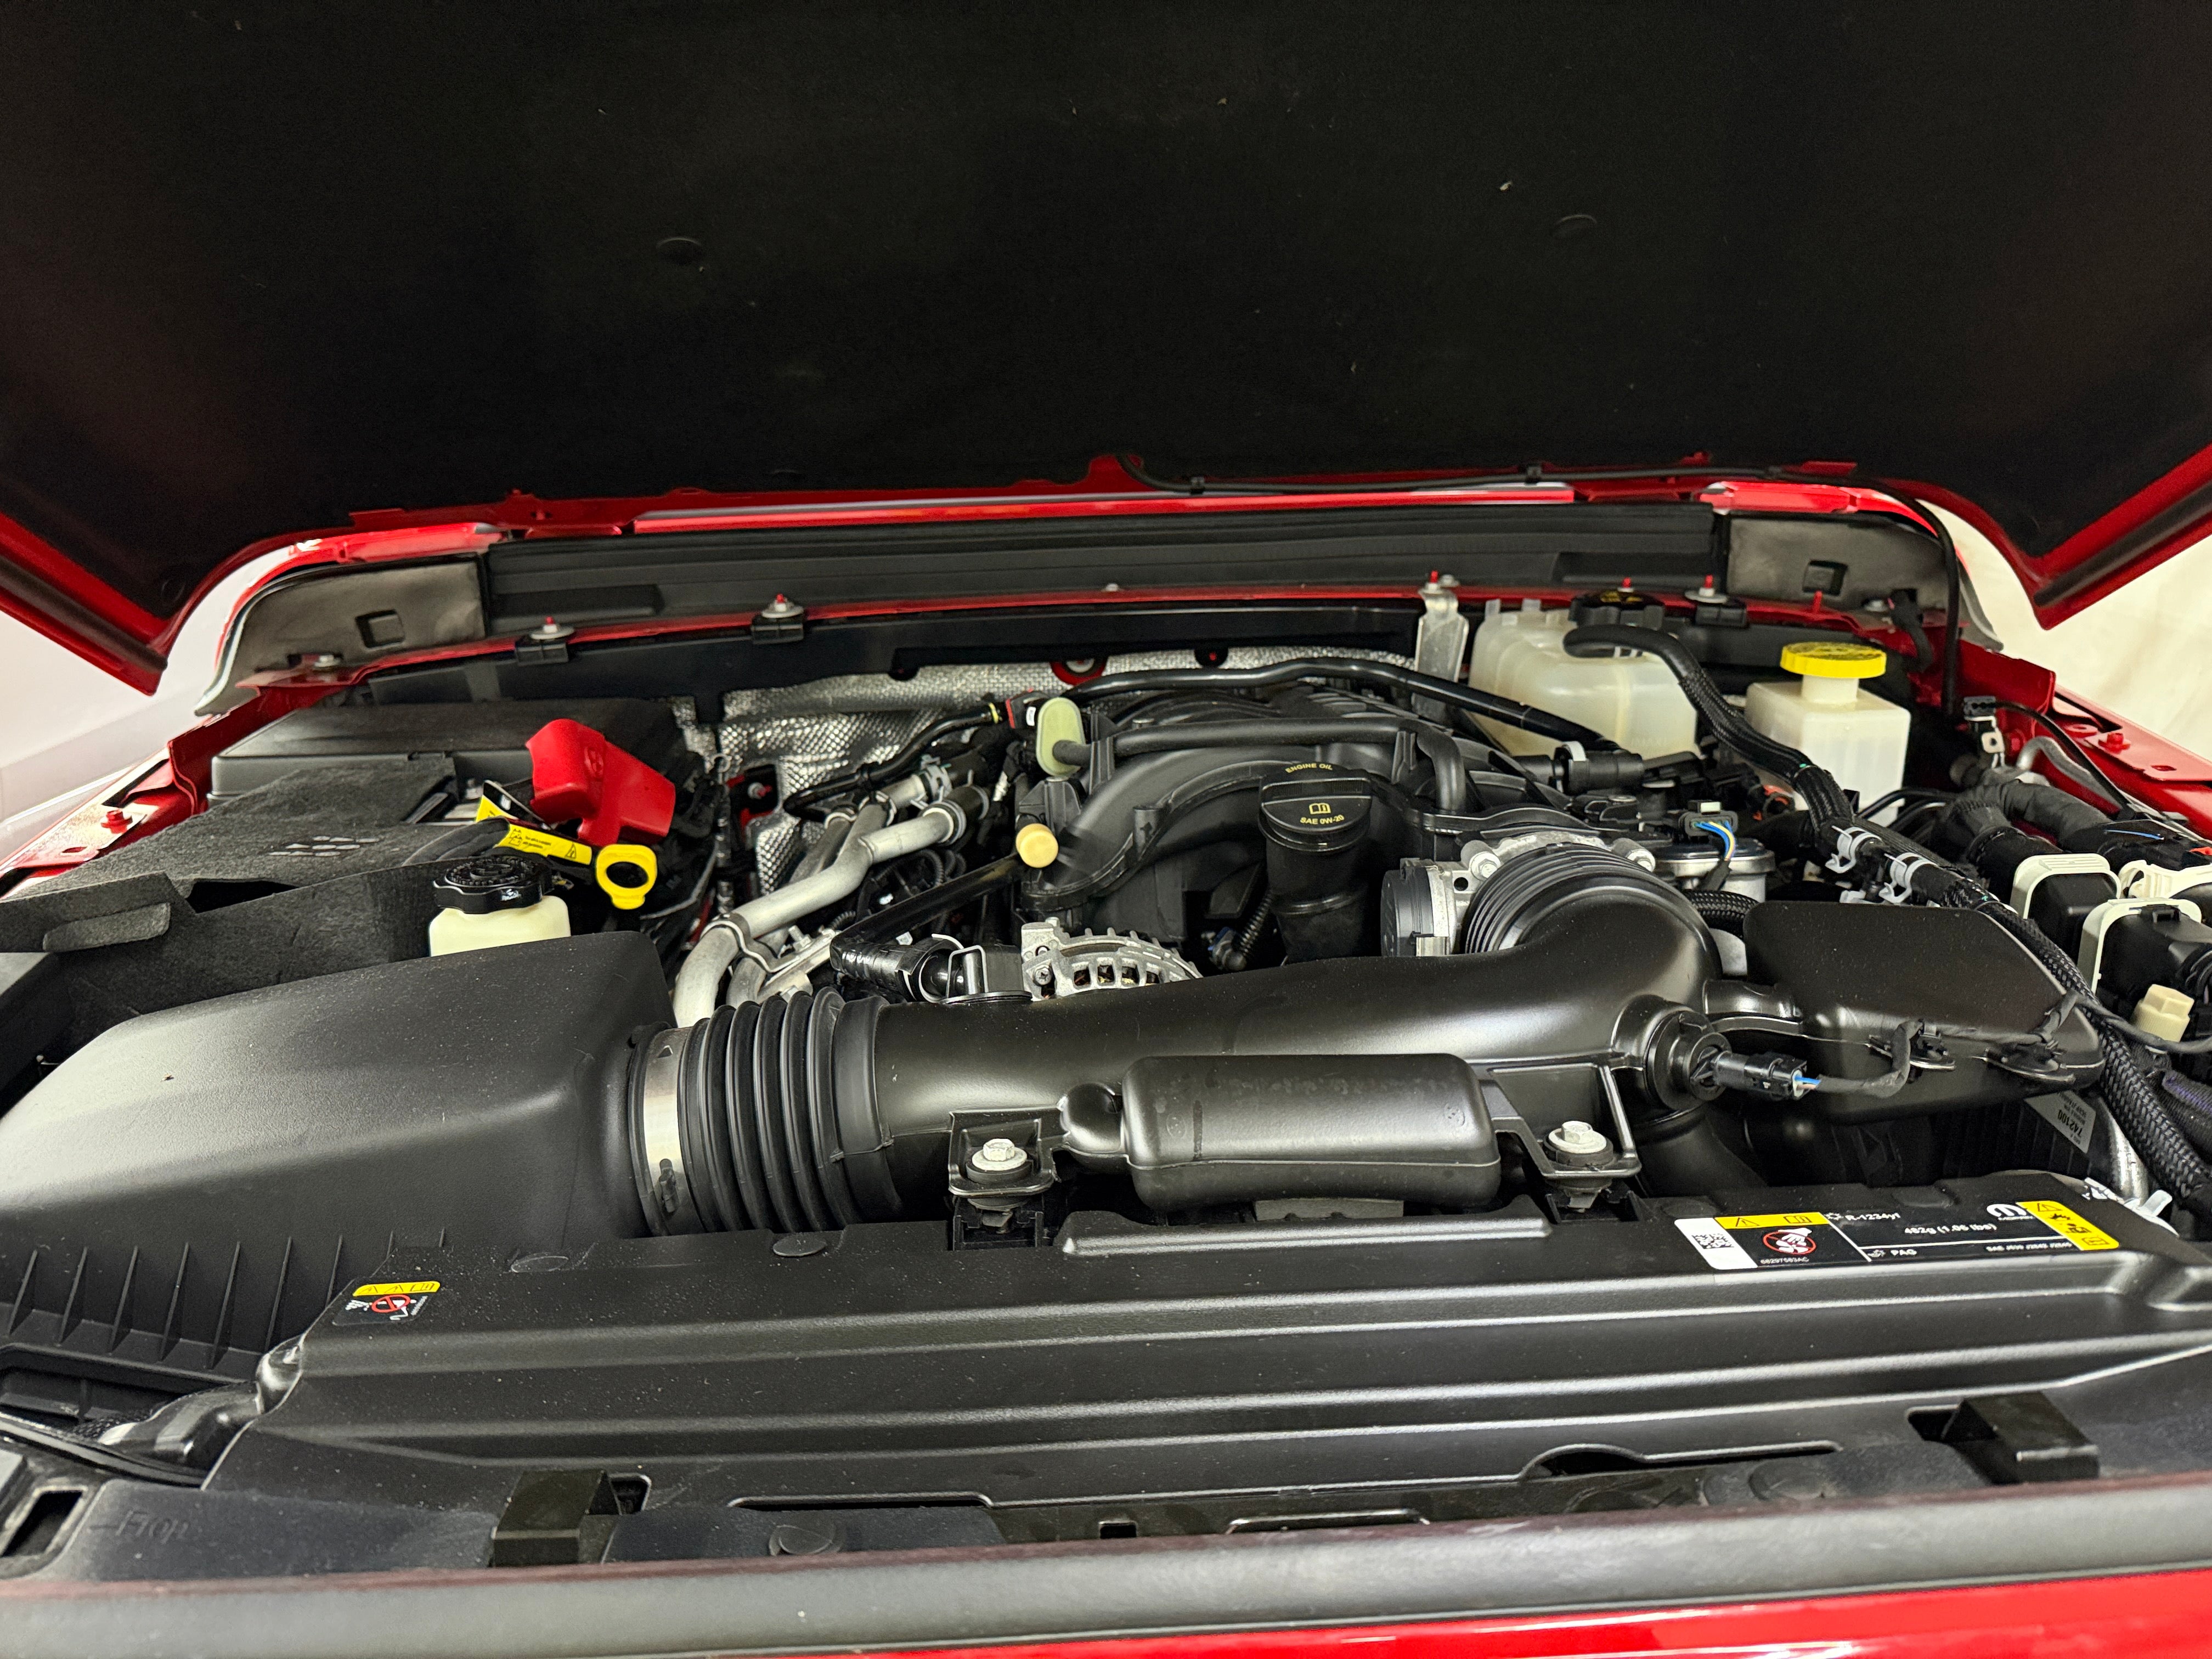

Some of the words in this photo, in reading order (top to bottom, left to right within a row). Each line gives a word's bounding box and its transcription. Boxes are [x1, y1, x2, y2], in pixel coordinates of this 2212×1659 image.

[1285, 763, 1317, 774] ENGINE
[1319, 763, 1333, 771] OIL
[1300, 817, 1318, 825] SAE
[1319, 814, 1345, 825] 0W-20
